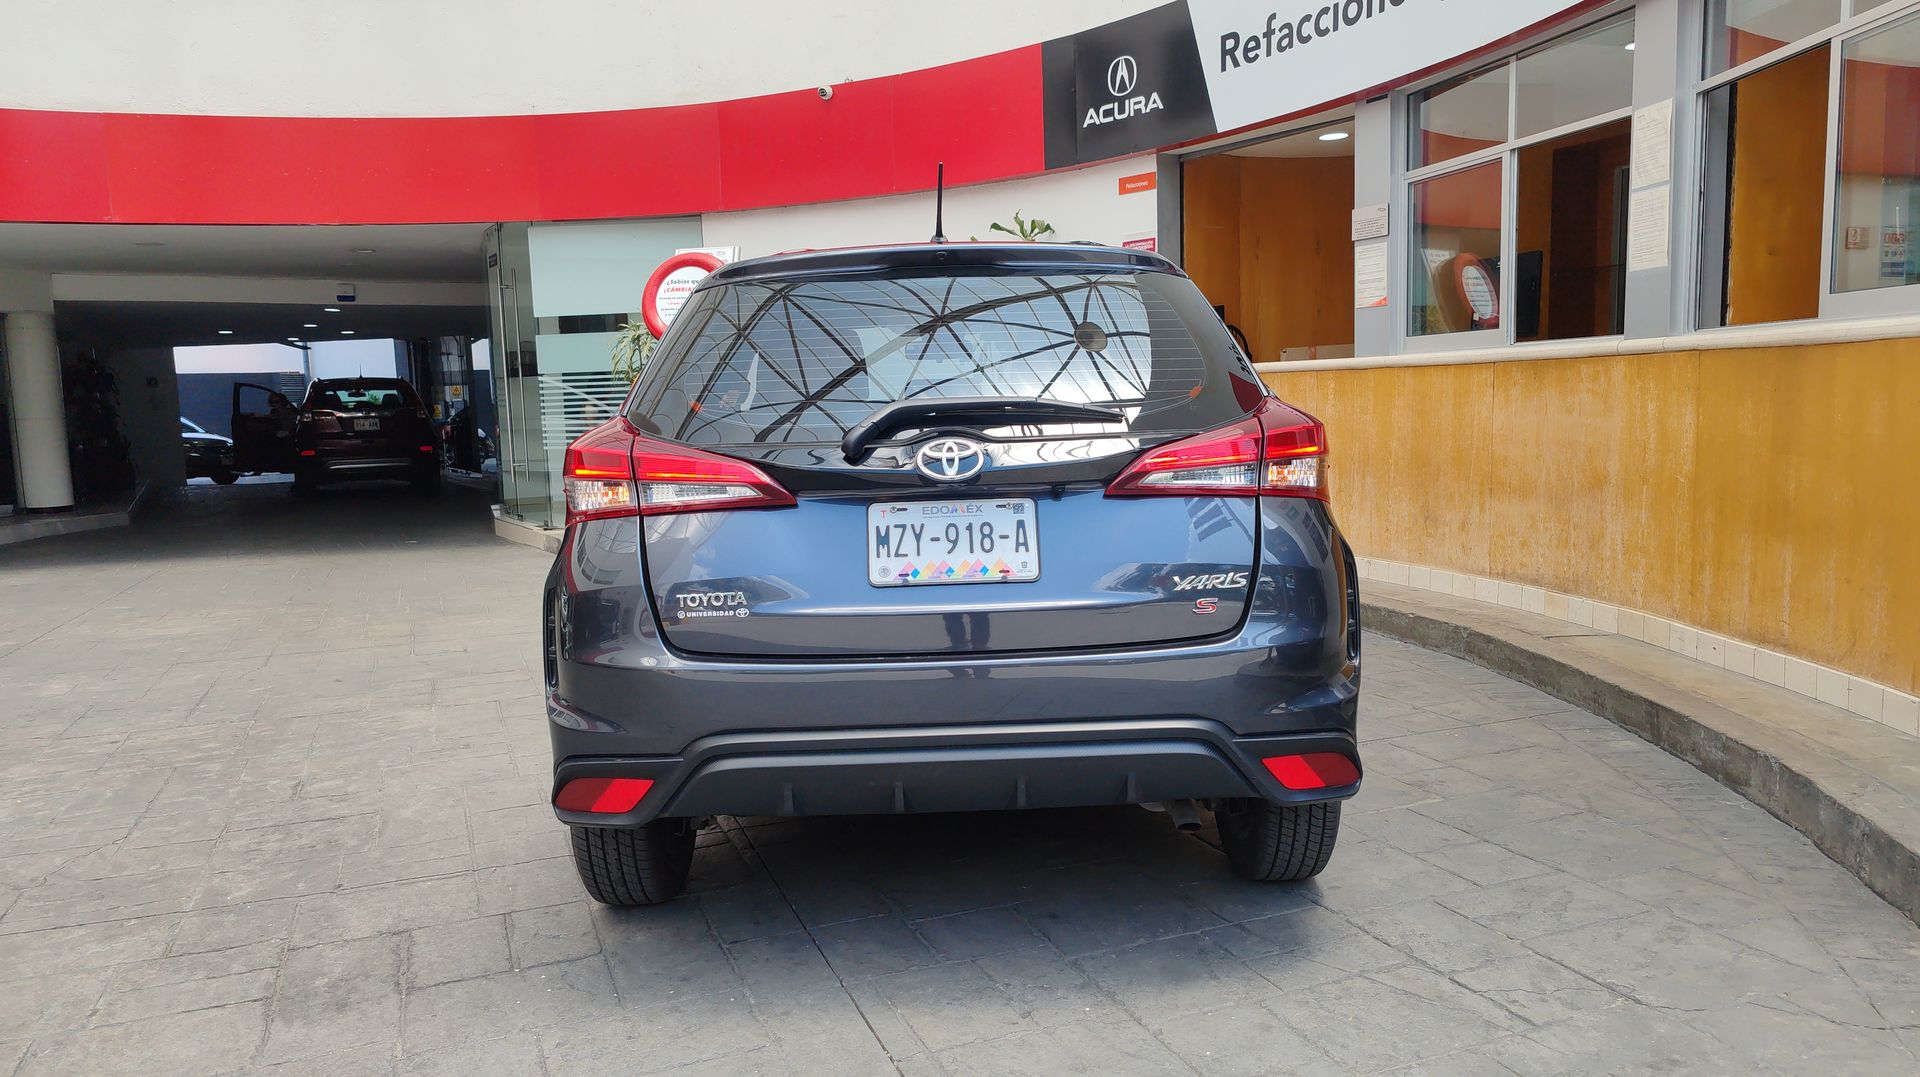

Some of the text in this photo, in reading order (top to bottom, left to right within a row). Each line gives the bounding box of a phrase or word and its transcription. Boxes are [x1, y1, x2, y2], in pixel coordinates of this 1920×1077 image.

[1220, 0, 1404, 72] Refaccion
[1082, 91, 1164, 128] ACURA
[875, 519, 1030, 559] MZY-918-A
[1172, 572, 1249, 591] YARIS
[676, 591, 748, 608] TOYOTA
[1192, 597, 1219, 614] S
[686, 610, 735, 618] UNIVERSIDAD
